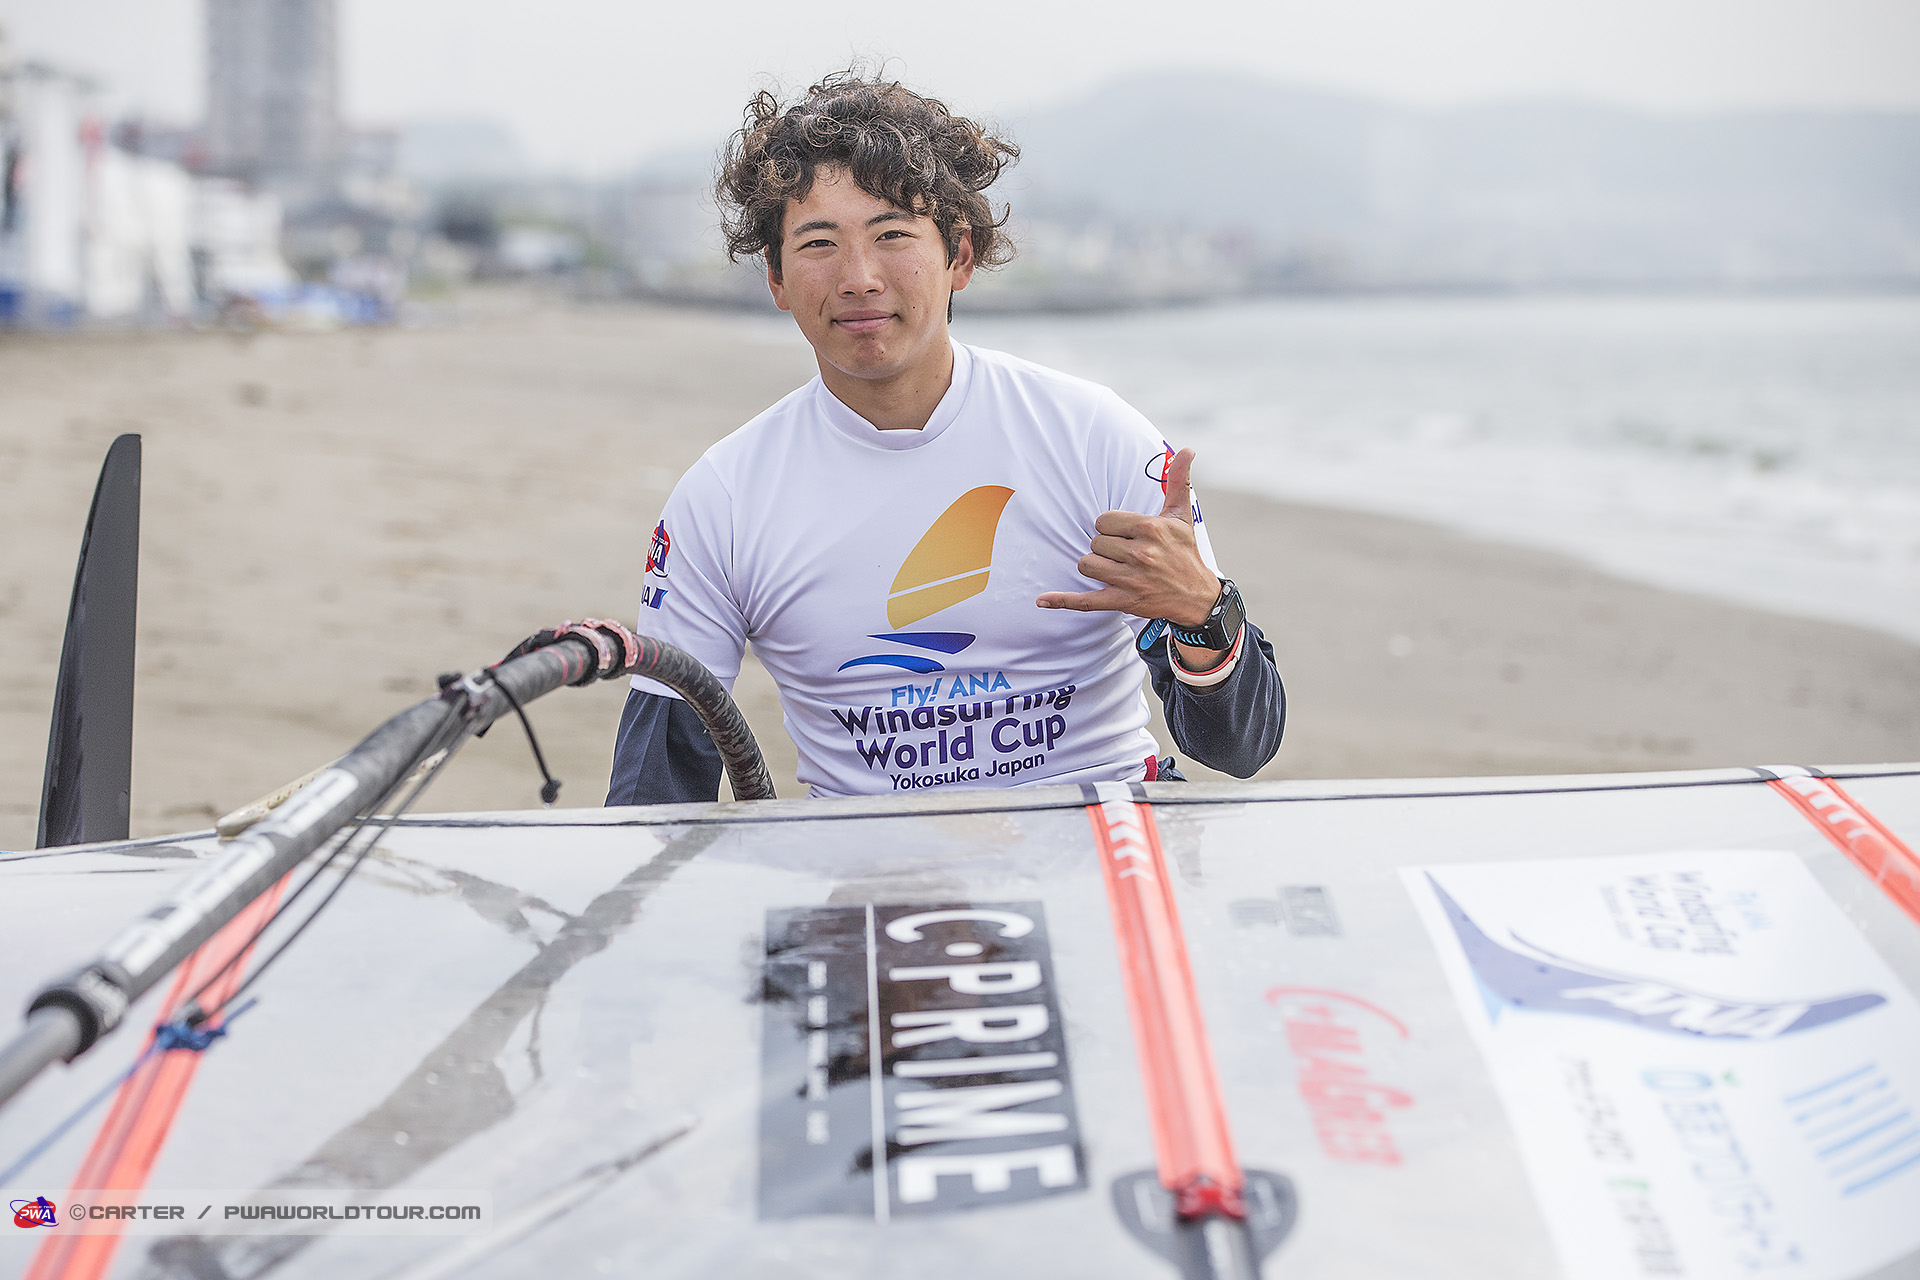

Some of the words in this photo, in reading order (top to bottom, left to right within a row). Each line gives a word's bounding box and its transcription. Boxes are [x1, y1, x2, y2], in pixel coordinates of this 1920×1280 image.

[891, 678, 942, 707] Fly!
[948, 671, 1011, 699] ANA
[856, 726, 974, 770] World
[991, 714, 1066, 751] Cup
[890, 766, 980, 790] Yokosuka
[985, 753, 1045, 777] Japan
